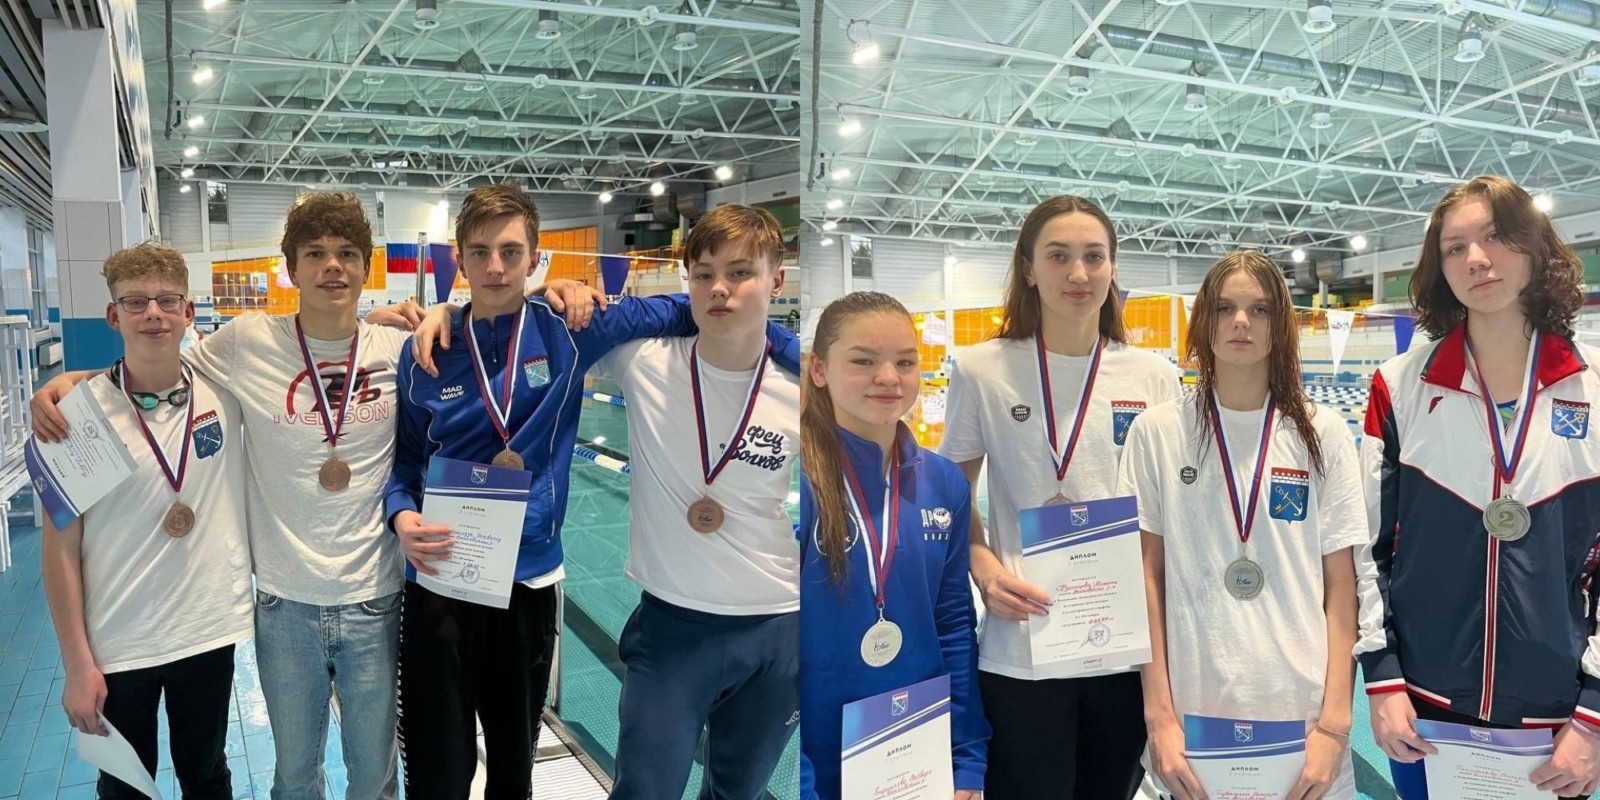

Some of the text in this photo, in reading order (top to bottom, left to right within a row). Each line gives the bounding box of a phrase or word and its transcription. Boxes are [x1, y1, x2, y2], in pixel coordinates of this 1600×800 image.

[442, 385, 463, 394] MAD
[440, 390, 465, 401] WAVE
[1498, 510, 1515, 529] 2
[1070, 552, 1097, 560] ДИПЛОМ
[887, 743, 912, 757] ДИПЛОМ
